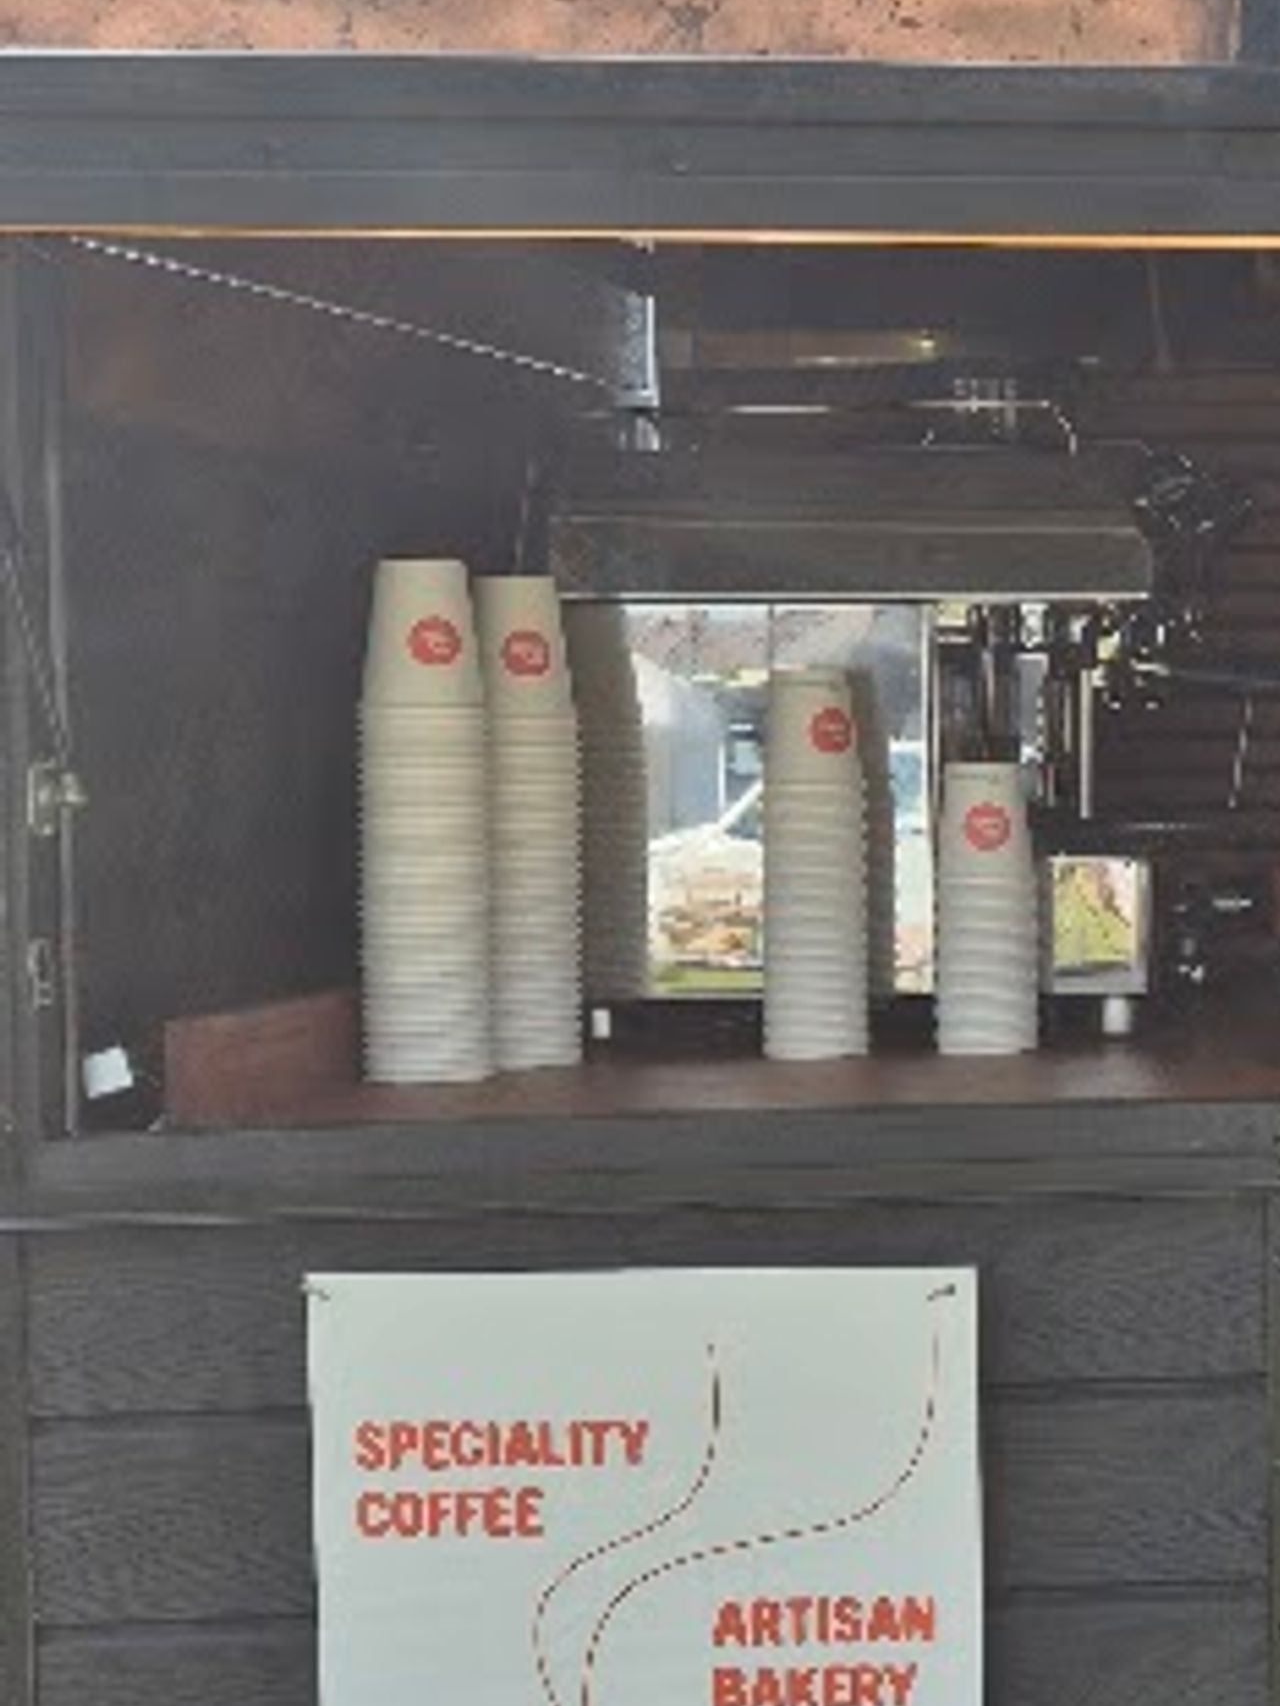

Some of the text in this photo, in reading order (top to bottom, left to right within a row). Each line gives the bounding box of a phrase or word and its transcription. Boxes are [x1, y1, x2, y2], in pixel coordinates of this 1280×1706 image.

[353, 1420, 651, 1471] SPECIALITY
[354, 1486, 545, 1539] COFFEE
[711, 1596, 936, 1648] ARTISAN
